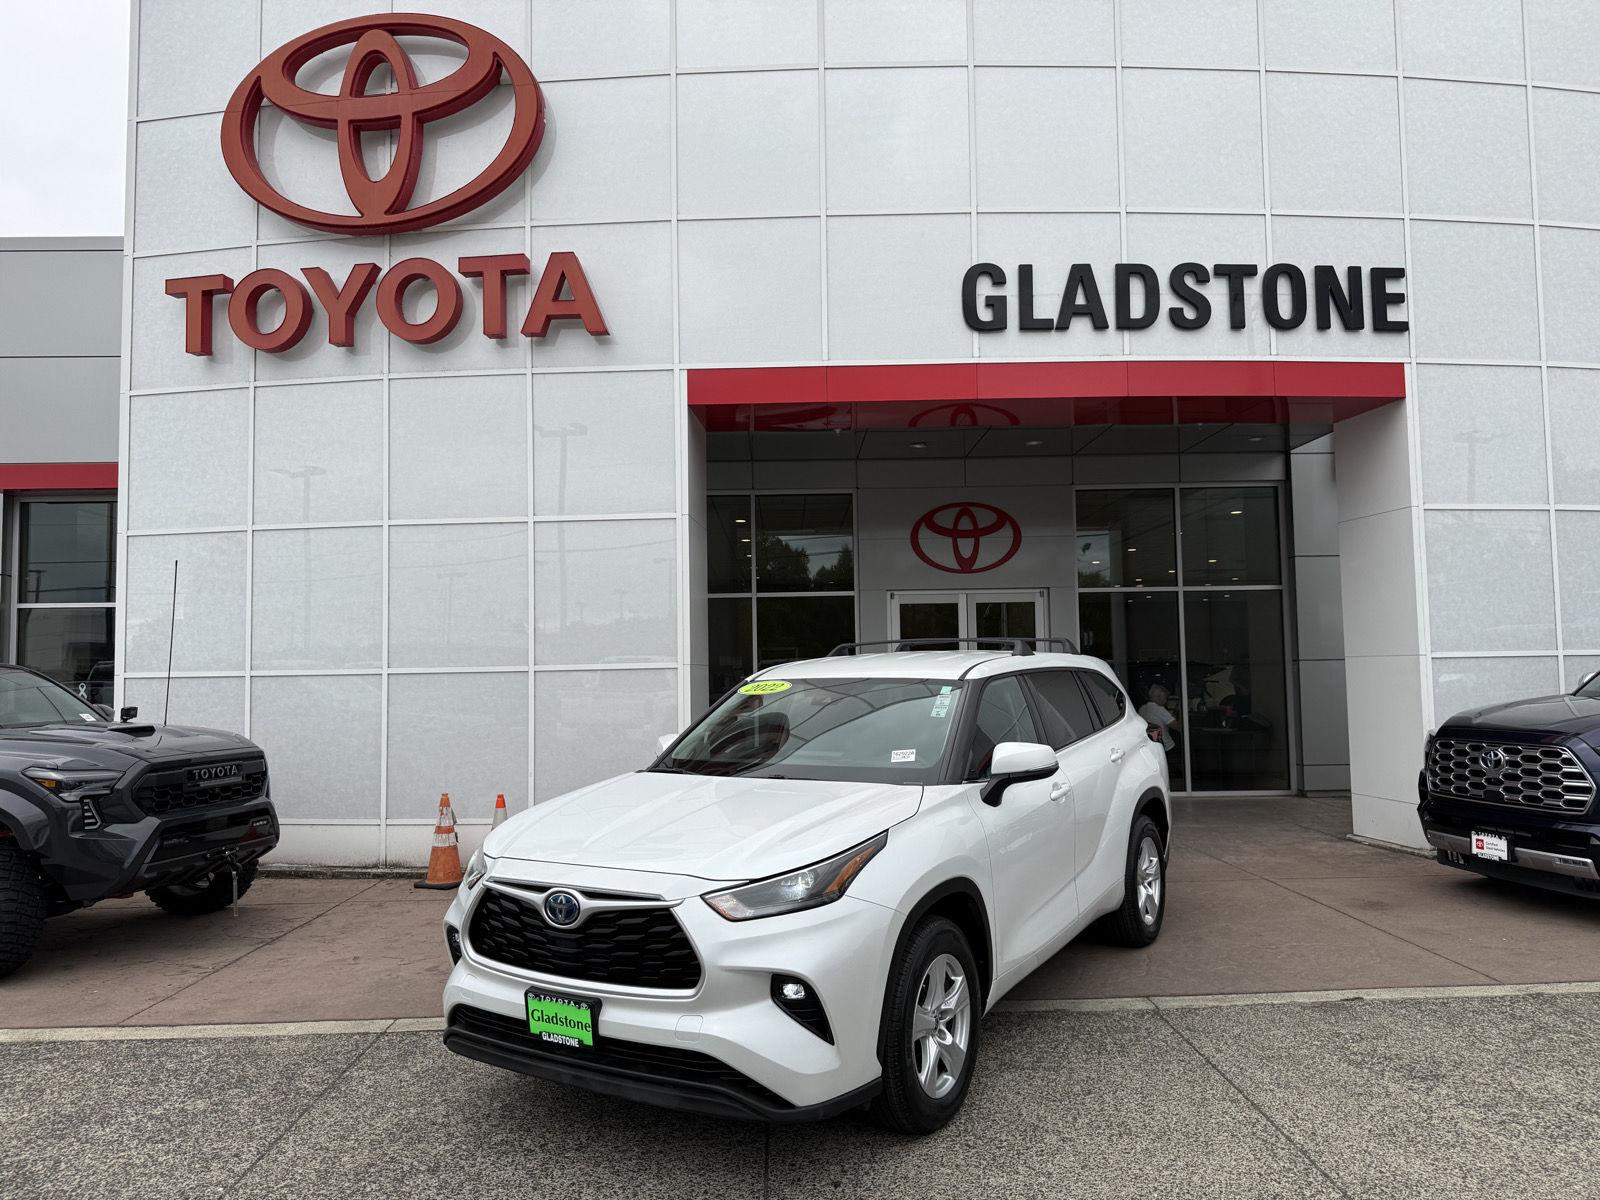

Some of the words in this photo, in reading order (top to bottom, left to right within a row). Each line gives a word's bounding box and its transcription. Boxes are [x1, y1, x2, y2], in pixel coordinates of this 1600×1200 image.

[165, 251, 610, 356] TOYOTA
[961, 262, 1409, 333] GLADSTONE
[193, 765, 238, 780] TOYOTA
[540, 994, 576, 1008] TOYOTA
[530, 1008, 592, 1033] Gladstone
[541, 1032, 580, 1048] GLADSTONE
